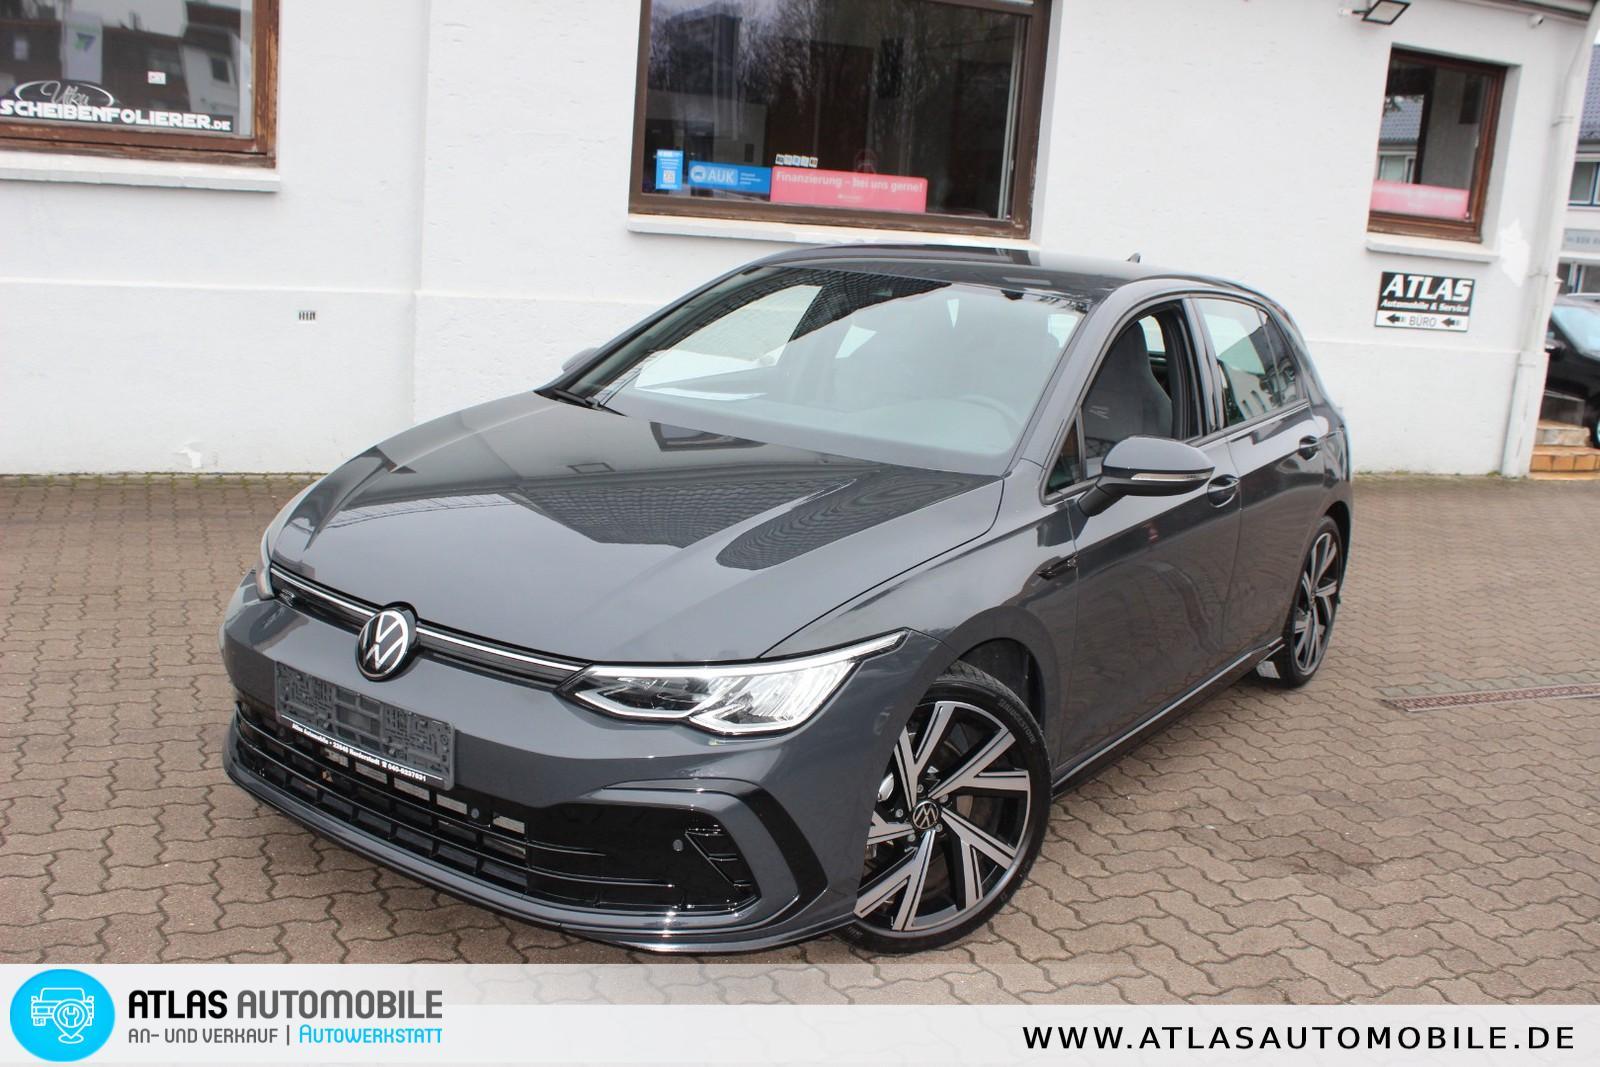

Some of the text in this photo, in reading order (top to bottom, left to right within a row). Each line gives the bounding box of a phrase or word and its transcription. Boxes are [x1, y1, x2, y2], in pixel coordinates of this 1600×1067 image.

[0, 99, 231, 131] SCHEIBENFOLIERER.DE
[707, 168, 736, 184] AUK
[776, 171, 842, 188] Finanzierung
[1382, 274, 1473, 302] ATLAS
[1409, 314, 1437, 327] BÜRO
